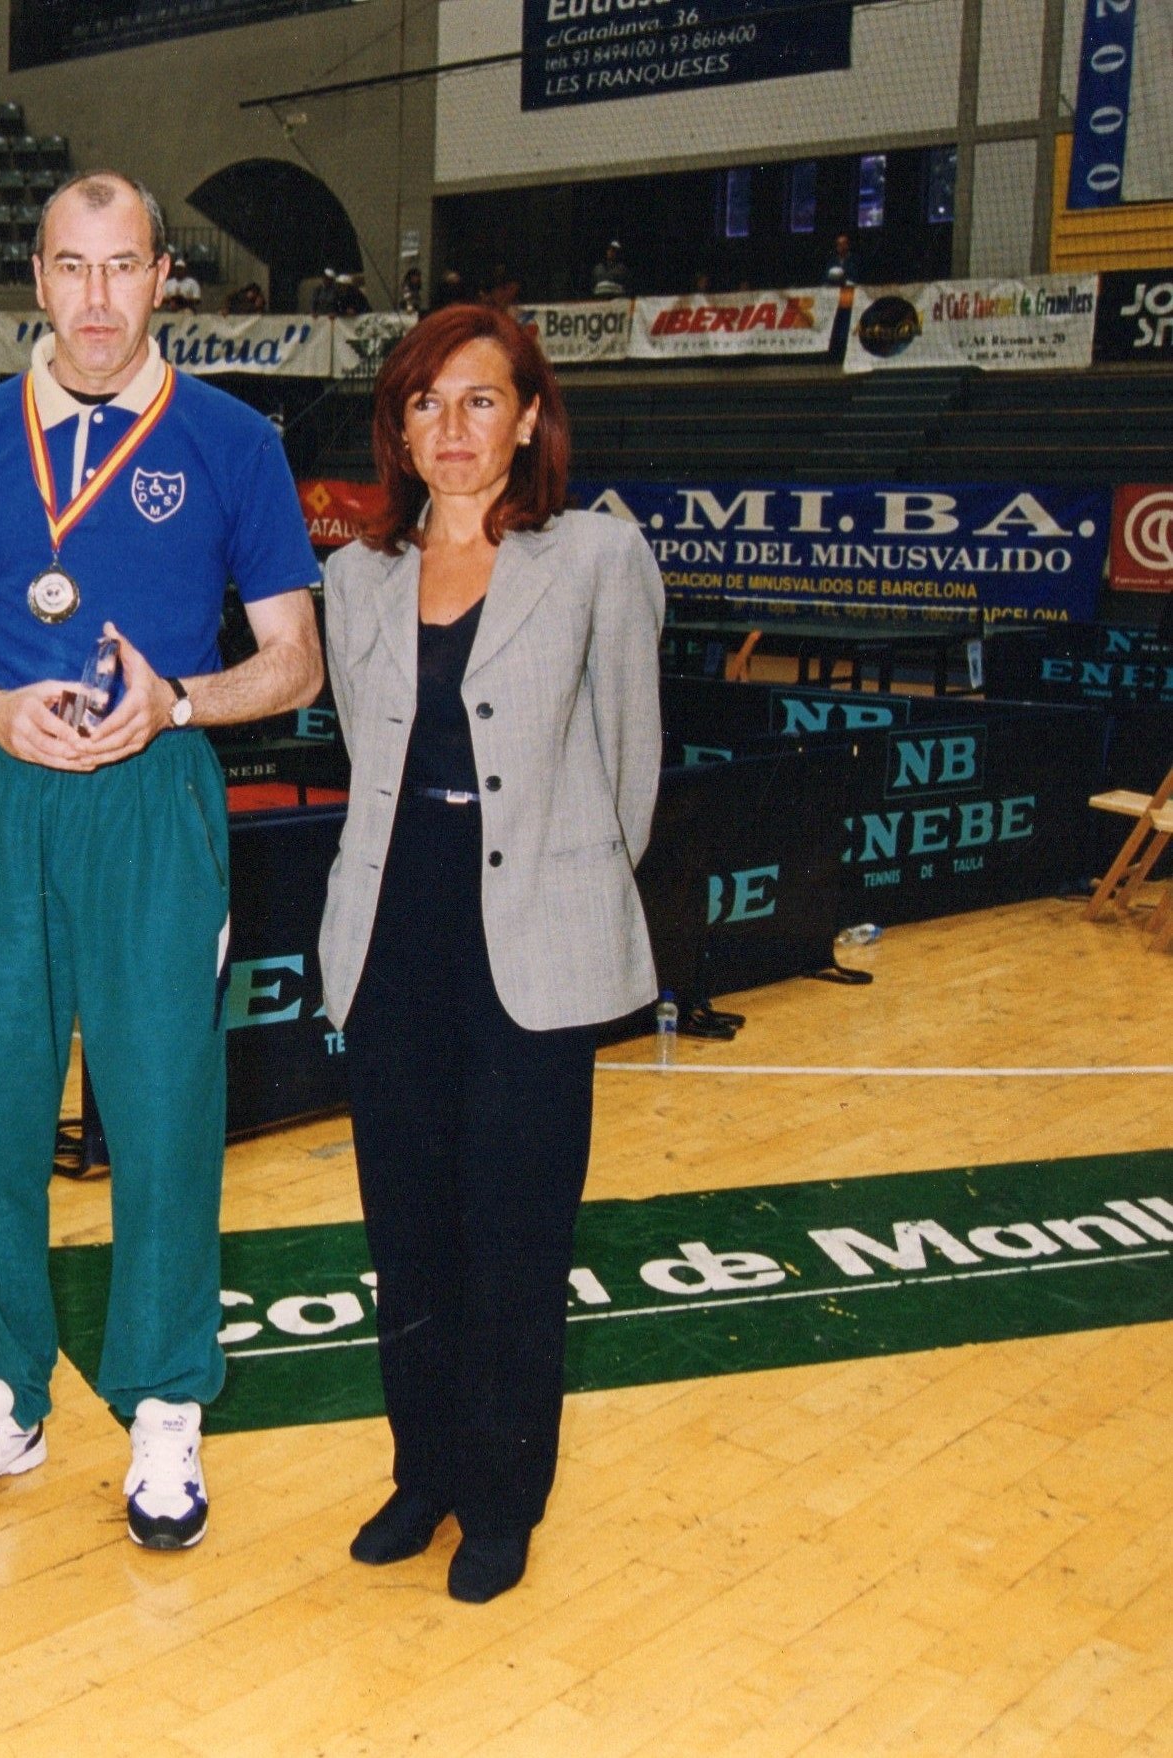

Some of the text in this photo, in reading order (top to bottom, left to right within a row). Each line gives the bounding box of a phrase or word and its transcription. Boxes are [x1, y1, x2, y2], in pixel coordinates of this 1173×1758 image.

[545, 53, 732, 96] LES FRANQUESES
[649, 303, 779, 337] IBERIA
[652, 539, 1073, 573] PON DEL MINUSVALIDO
[726, 573, 745, 590] DE
[748, 575, 854, 594] MINUSVALIDOS
[857, 578, 877, 596] DE
[881, 579, 977, 599] BARCELONA
[228, 762, 277, 778] NEBE
[892, 736, 977, 789] NB
[864, 856, 985, 888] TENNIS DE TAULA
[639, 1241, 786, 1295] de
